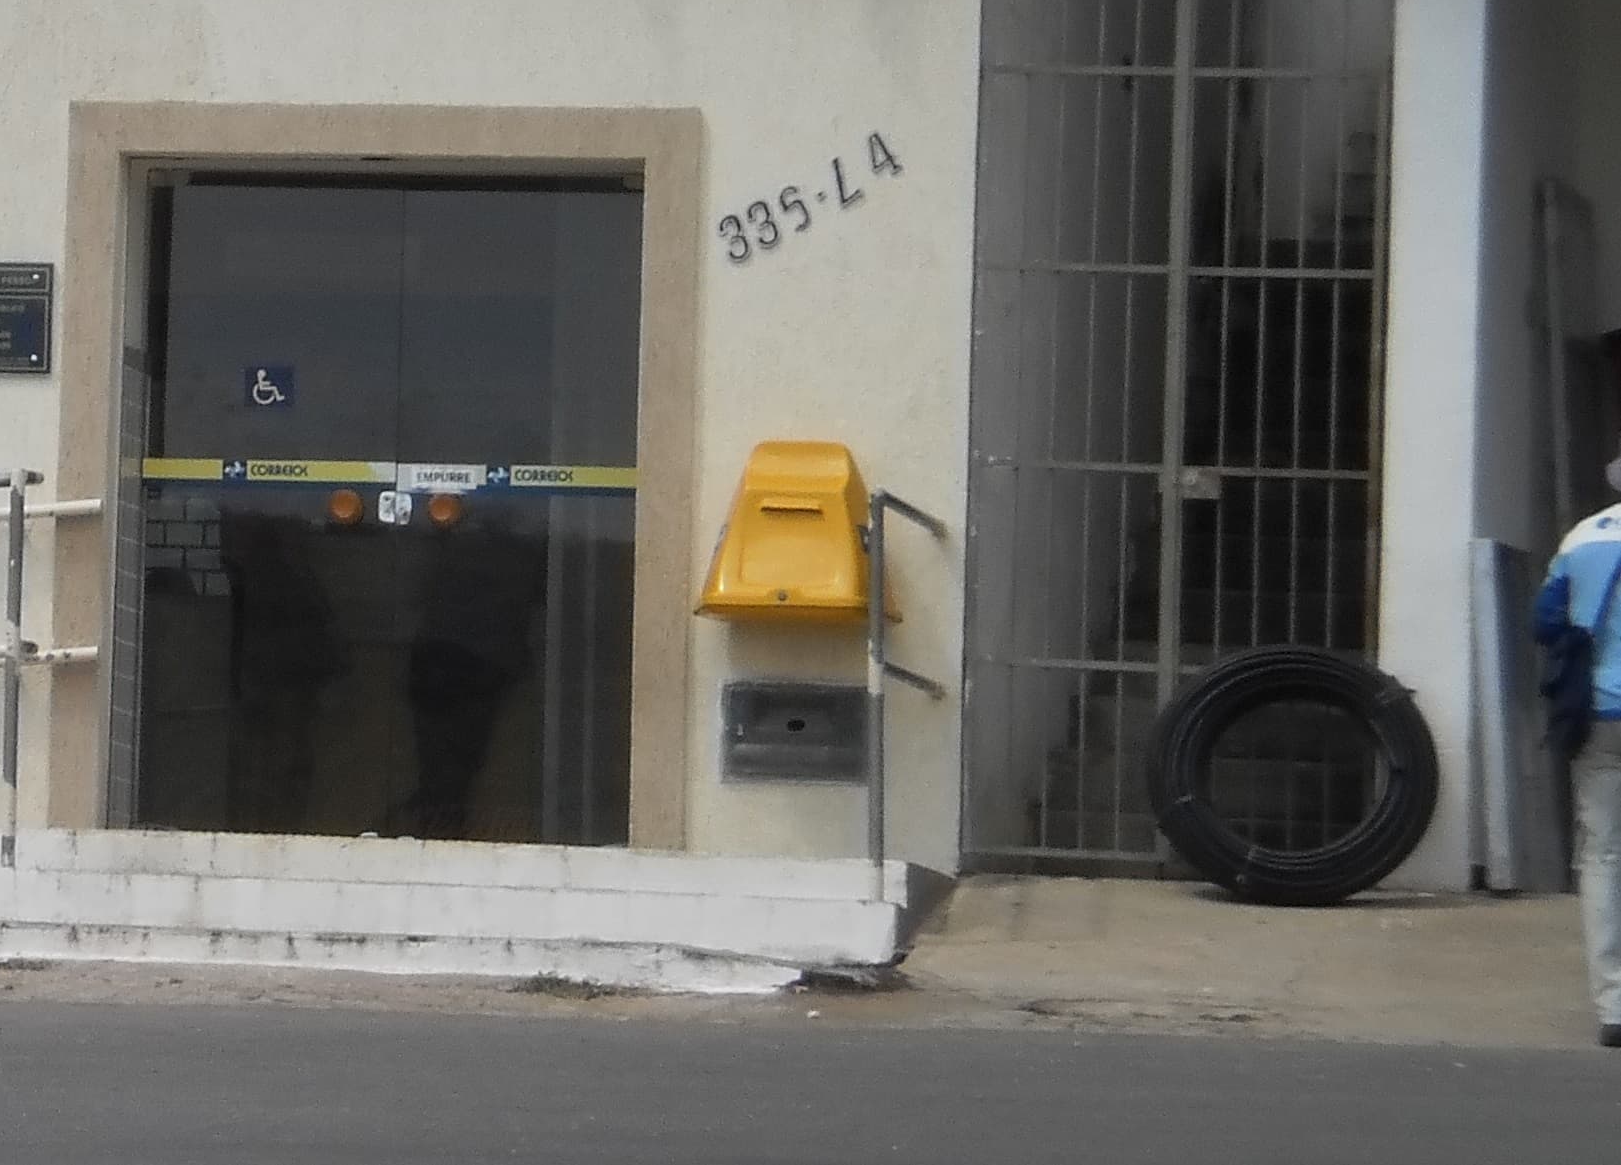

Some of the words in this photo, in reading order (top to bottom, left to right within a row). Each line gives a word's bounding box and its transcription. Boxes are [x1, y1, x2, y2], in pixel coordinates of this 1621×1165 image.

[250, 464, 308, 477] CORREIOS
[416, 470, 471, 484] EMPURRE
[514, 469, 573, 483] CORREIOS
